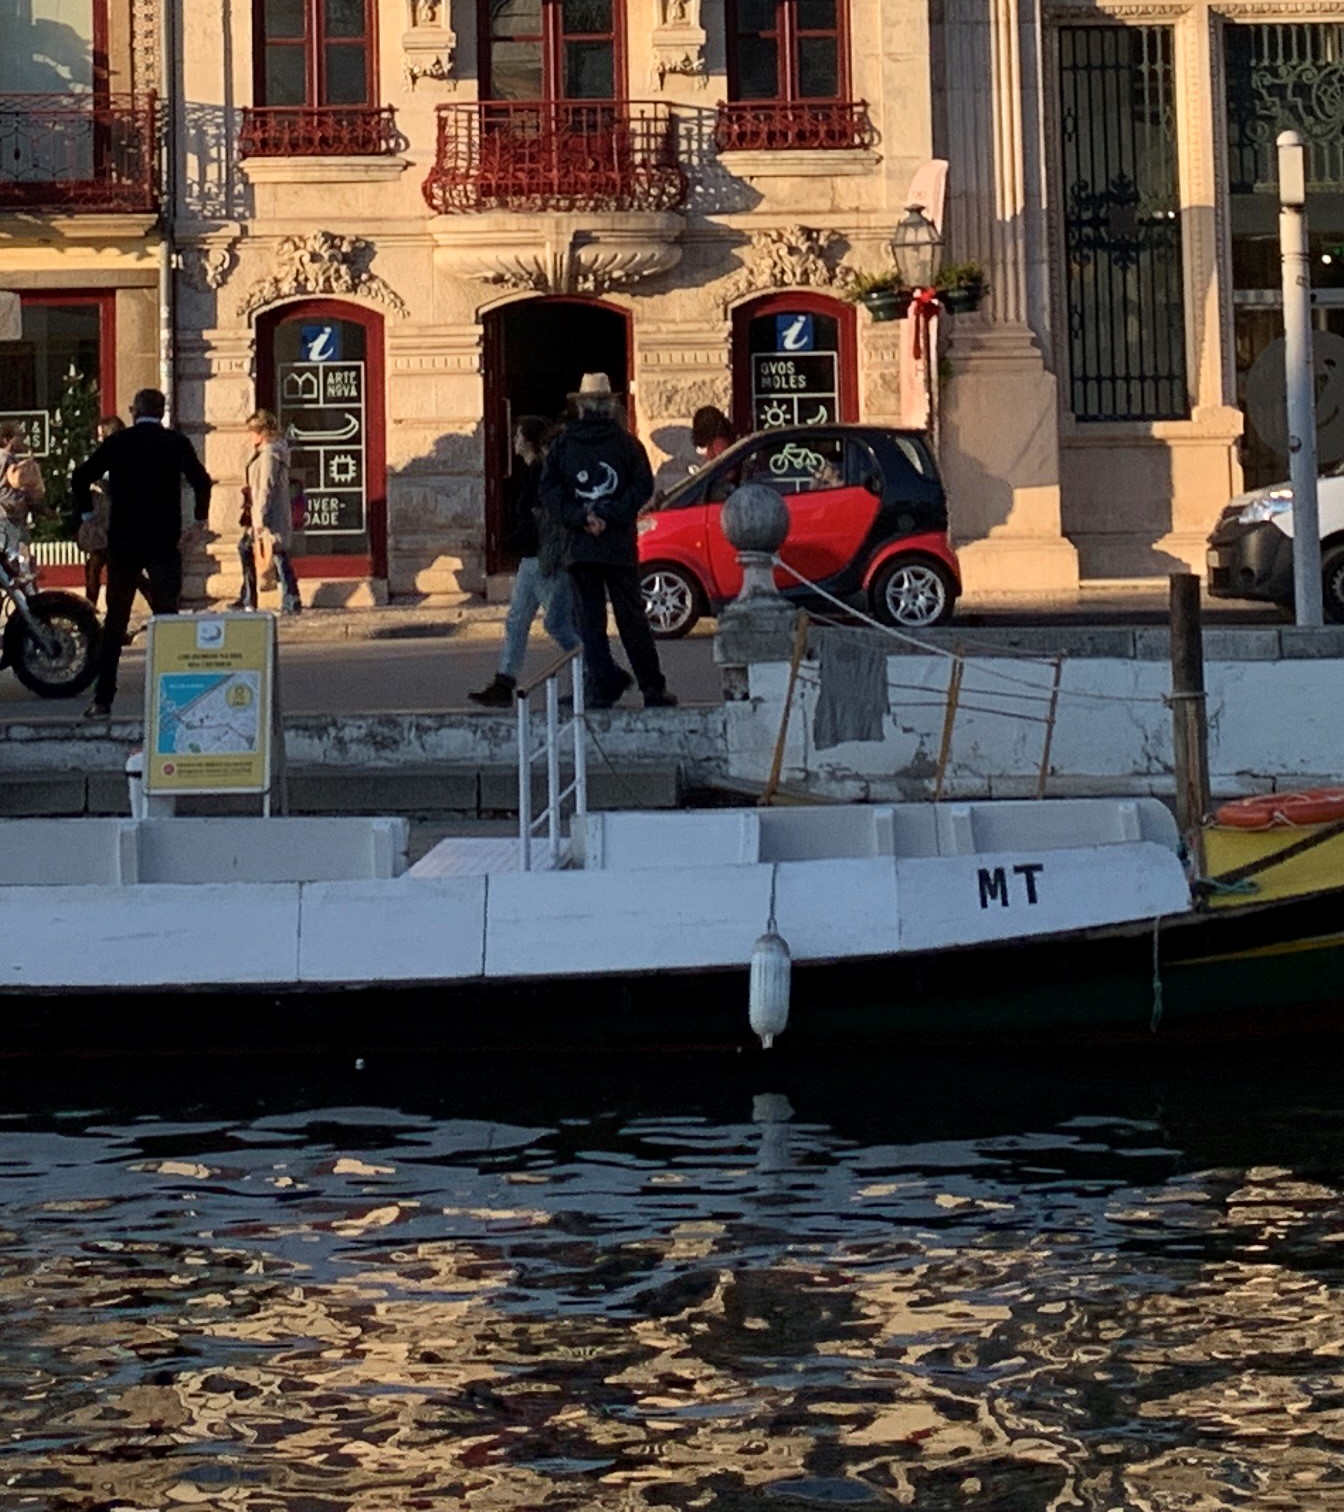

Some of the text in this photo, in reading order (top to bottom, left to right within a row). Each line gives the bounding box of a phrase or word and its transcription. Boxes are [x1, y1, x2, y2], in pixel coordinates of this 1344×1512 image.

[760, 361, 795, 374] OVOS
[327, 371, 357, 385] ARTE
[760, 375, 806, 388] MOLES
[327, 384, 357, 397] NOVA
[978, 863, 1044, 909] MT
